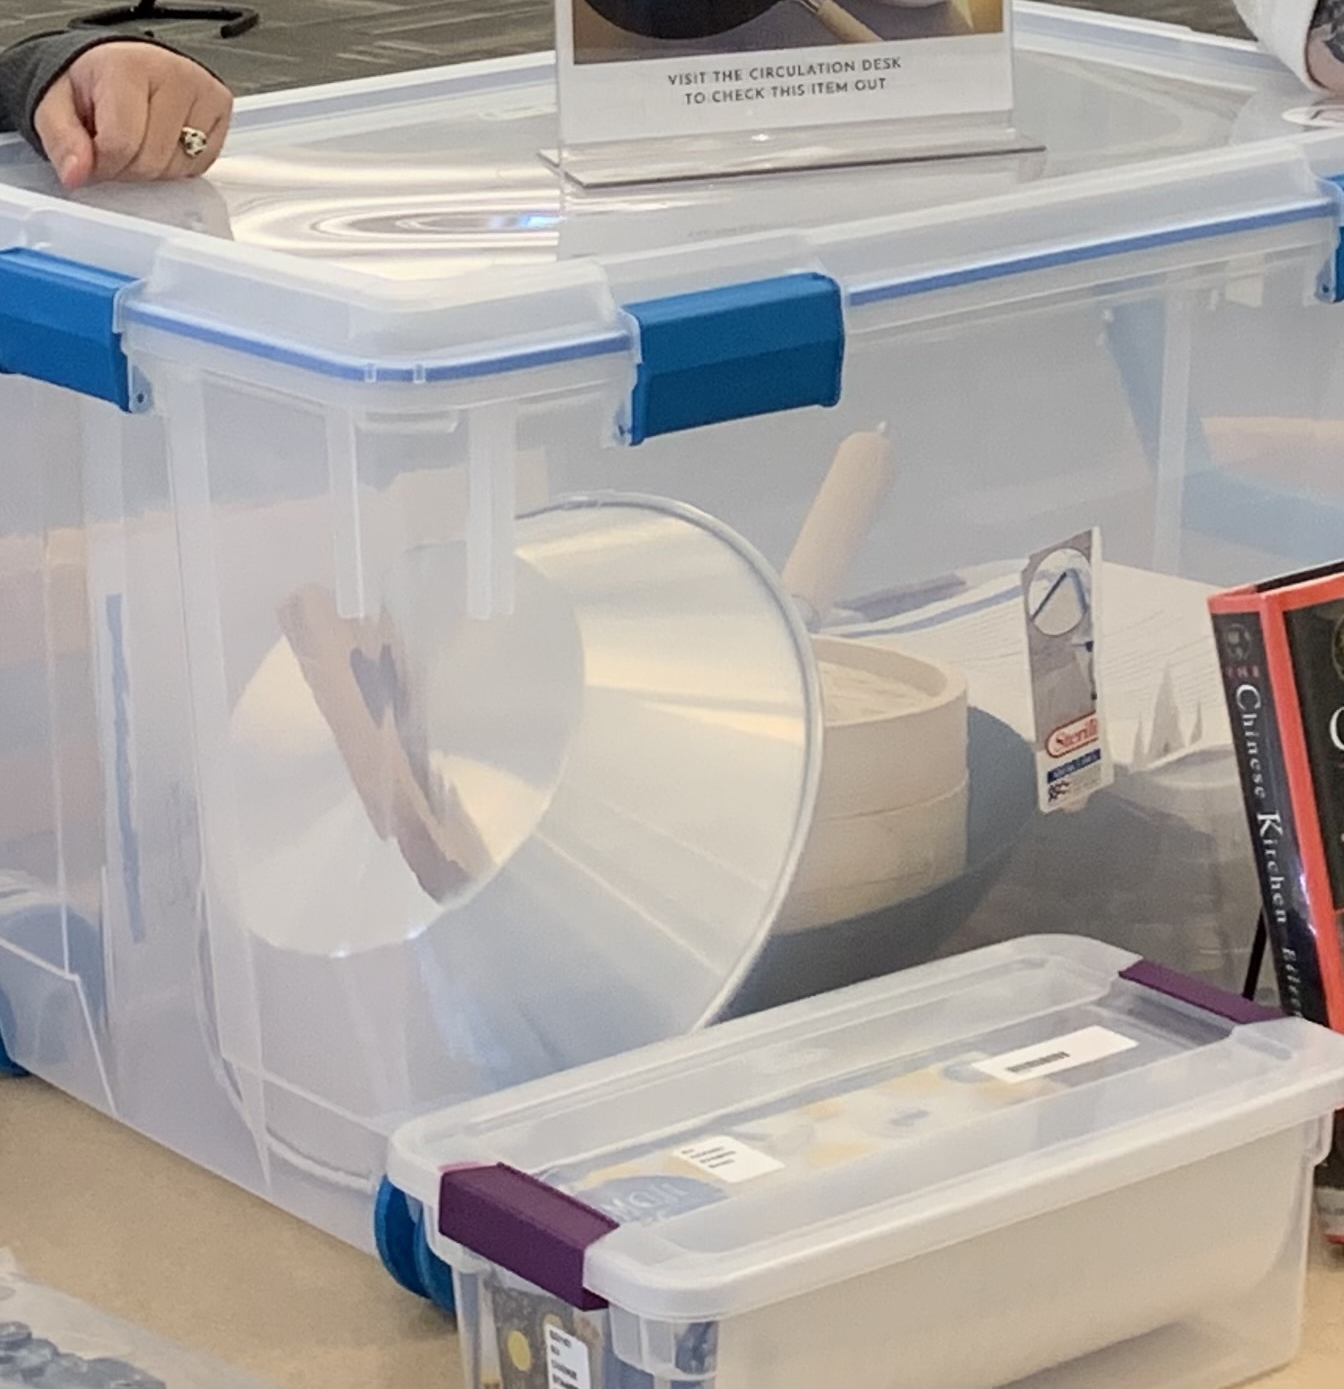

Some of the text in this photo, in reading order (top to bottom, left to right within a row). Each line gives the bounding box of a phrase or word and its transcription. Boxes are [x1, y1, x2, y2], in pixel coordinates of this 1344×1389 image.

[668, 56, 902, 86] VISIT THE CIRCULATION DESK
[685, 77, 887, 105] TO CHECK THIS ITEM OUT
[1235, 684, 1267, 799] Chinese
[1257, 810, 1287, 923] Kitchen
